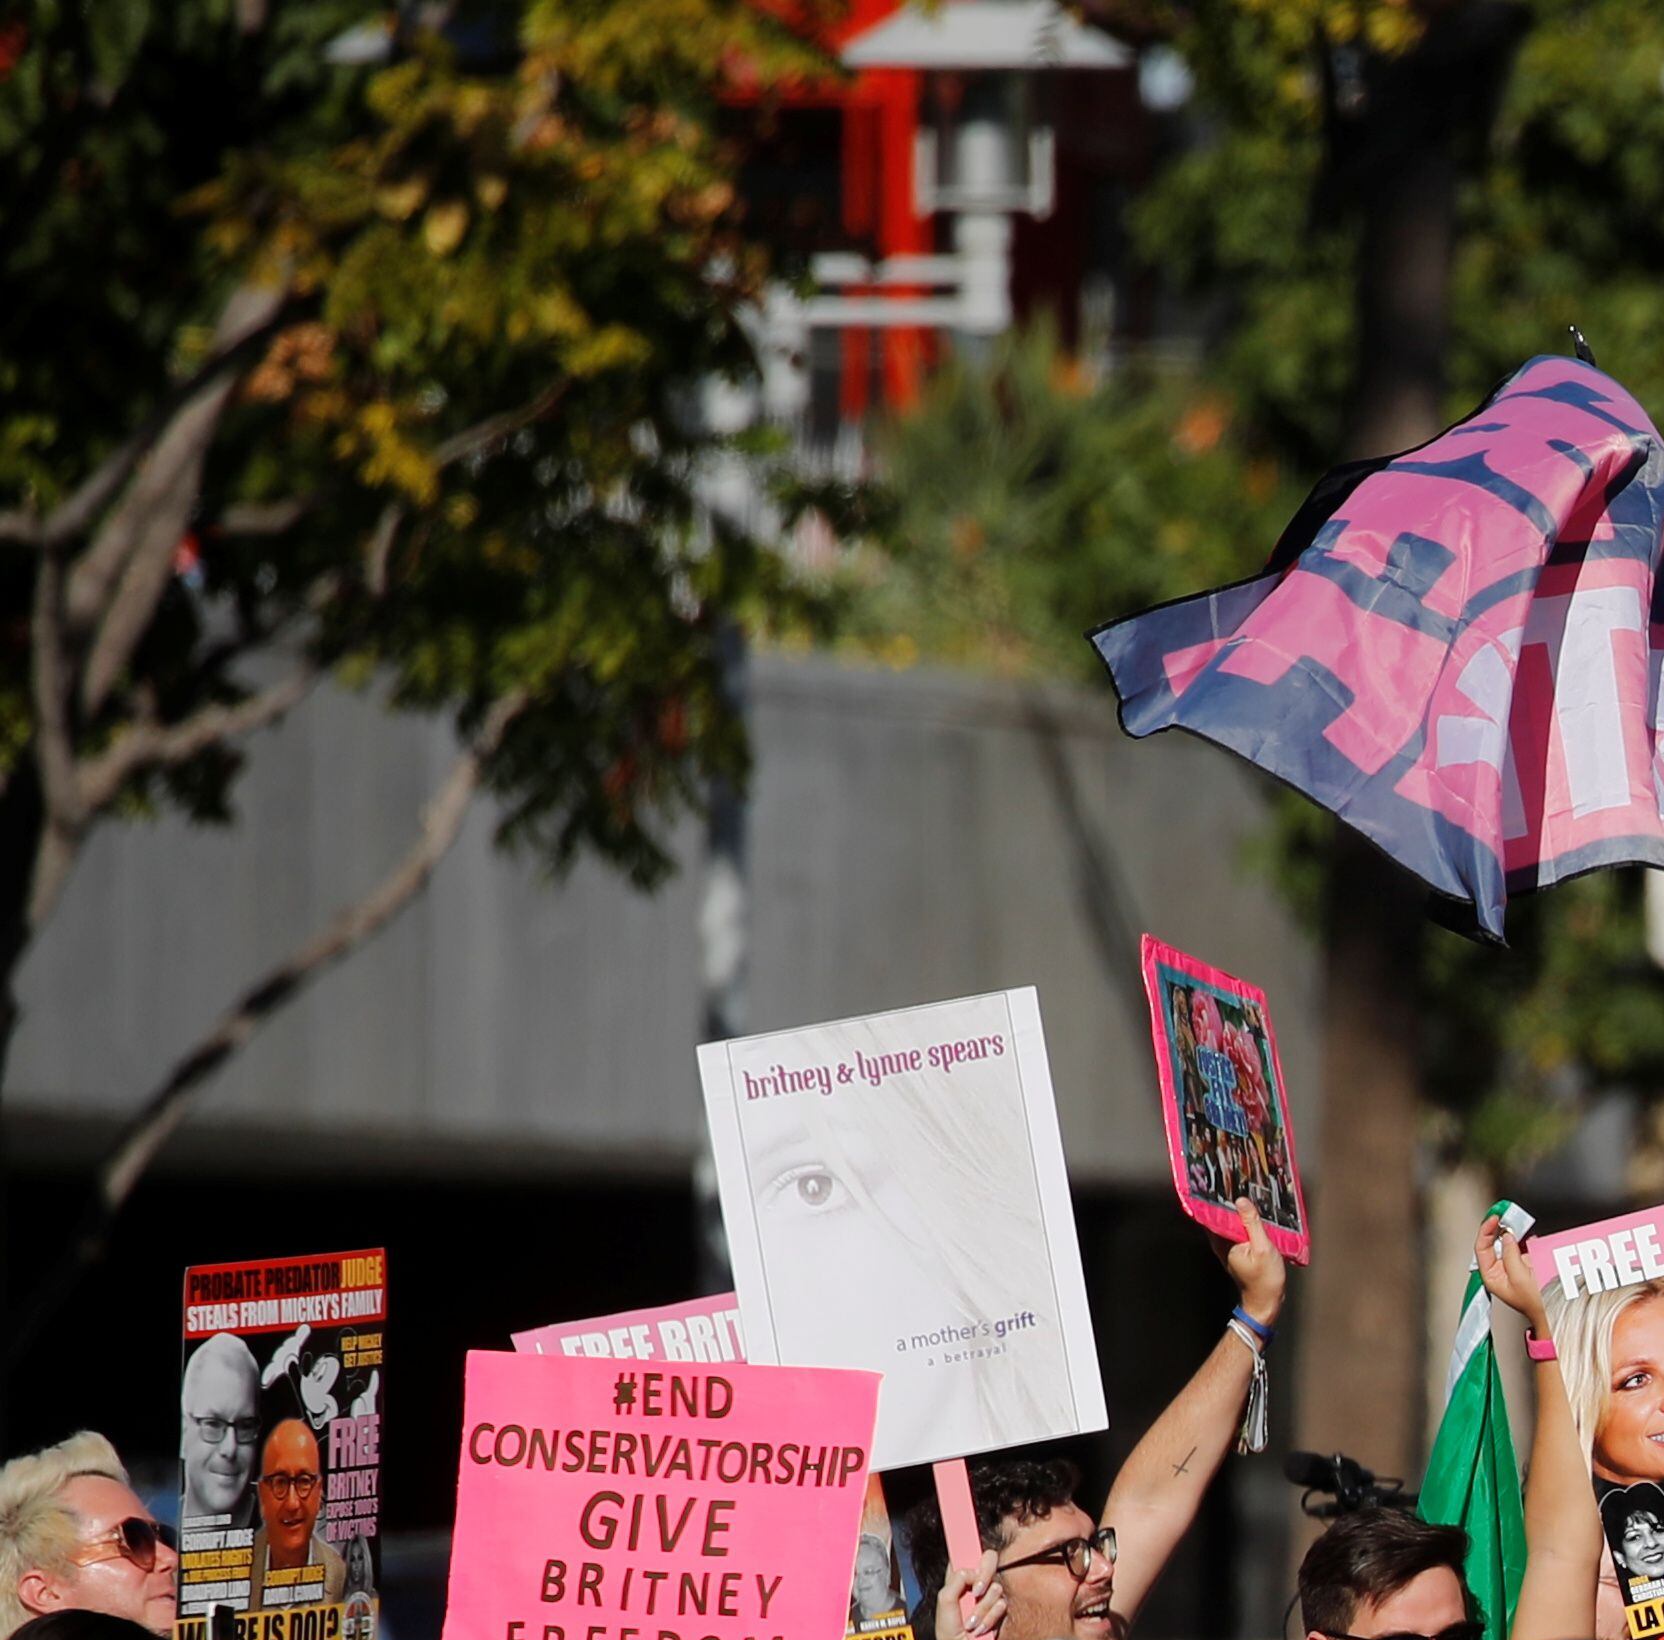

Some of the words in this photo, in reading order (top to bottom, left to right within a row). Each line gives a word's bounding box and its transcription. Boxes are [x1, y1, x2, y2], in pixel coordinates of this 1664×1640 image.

[743, 1063, 832, 1100] britney
[837, 1062, 854, 1084] &
[855, 1048, 923, 1087] lynne
[927, 1033, 1005, 1073] spears
[190, 1268, 262, 1303] PROBATE
[263, 1262, 340, 1297] PREDATOR
[340, 1255, 383, 1288] JUDGE
[186, 1302, 239, 1332] STEALS
[240, 1299, 280, 1327] FROM
[281, 1293, 340, 1324] MICKEY'S
[341, 1289, 383, 1318] FAMILY
[896, 1338, 907, 1352] a
[911, 1319, 990, 1349] mother's
[994, 1311, 1036, 1339] grift
[944, 1343, 1007, 1364] betrayal
[613, 1372, 734, 1419] #END
[328, 1414, 380, 1469] FREE
[469, 1422, 865, 1488] CONSERVATORSHIP
[328, 1468, 379, 1501] BRITNEY
[579, 1490, 736, 1557] GIVE
[540, 1559, 784, 1619] BRITNEY
[1633, 1605, 1660, 1632] LA
